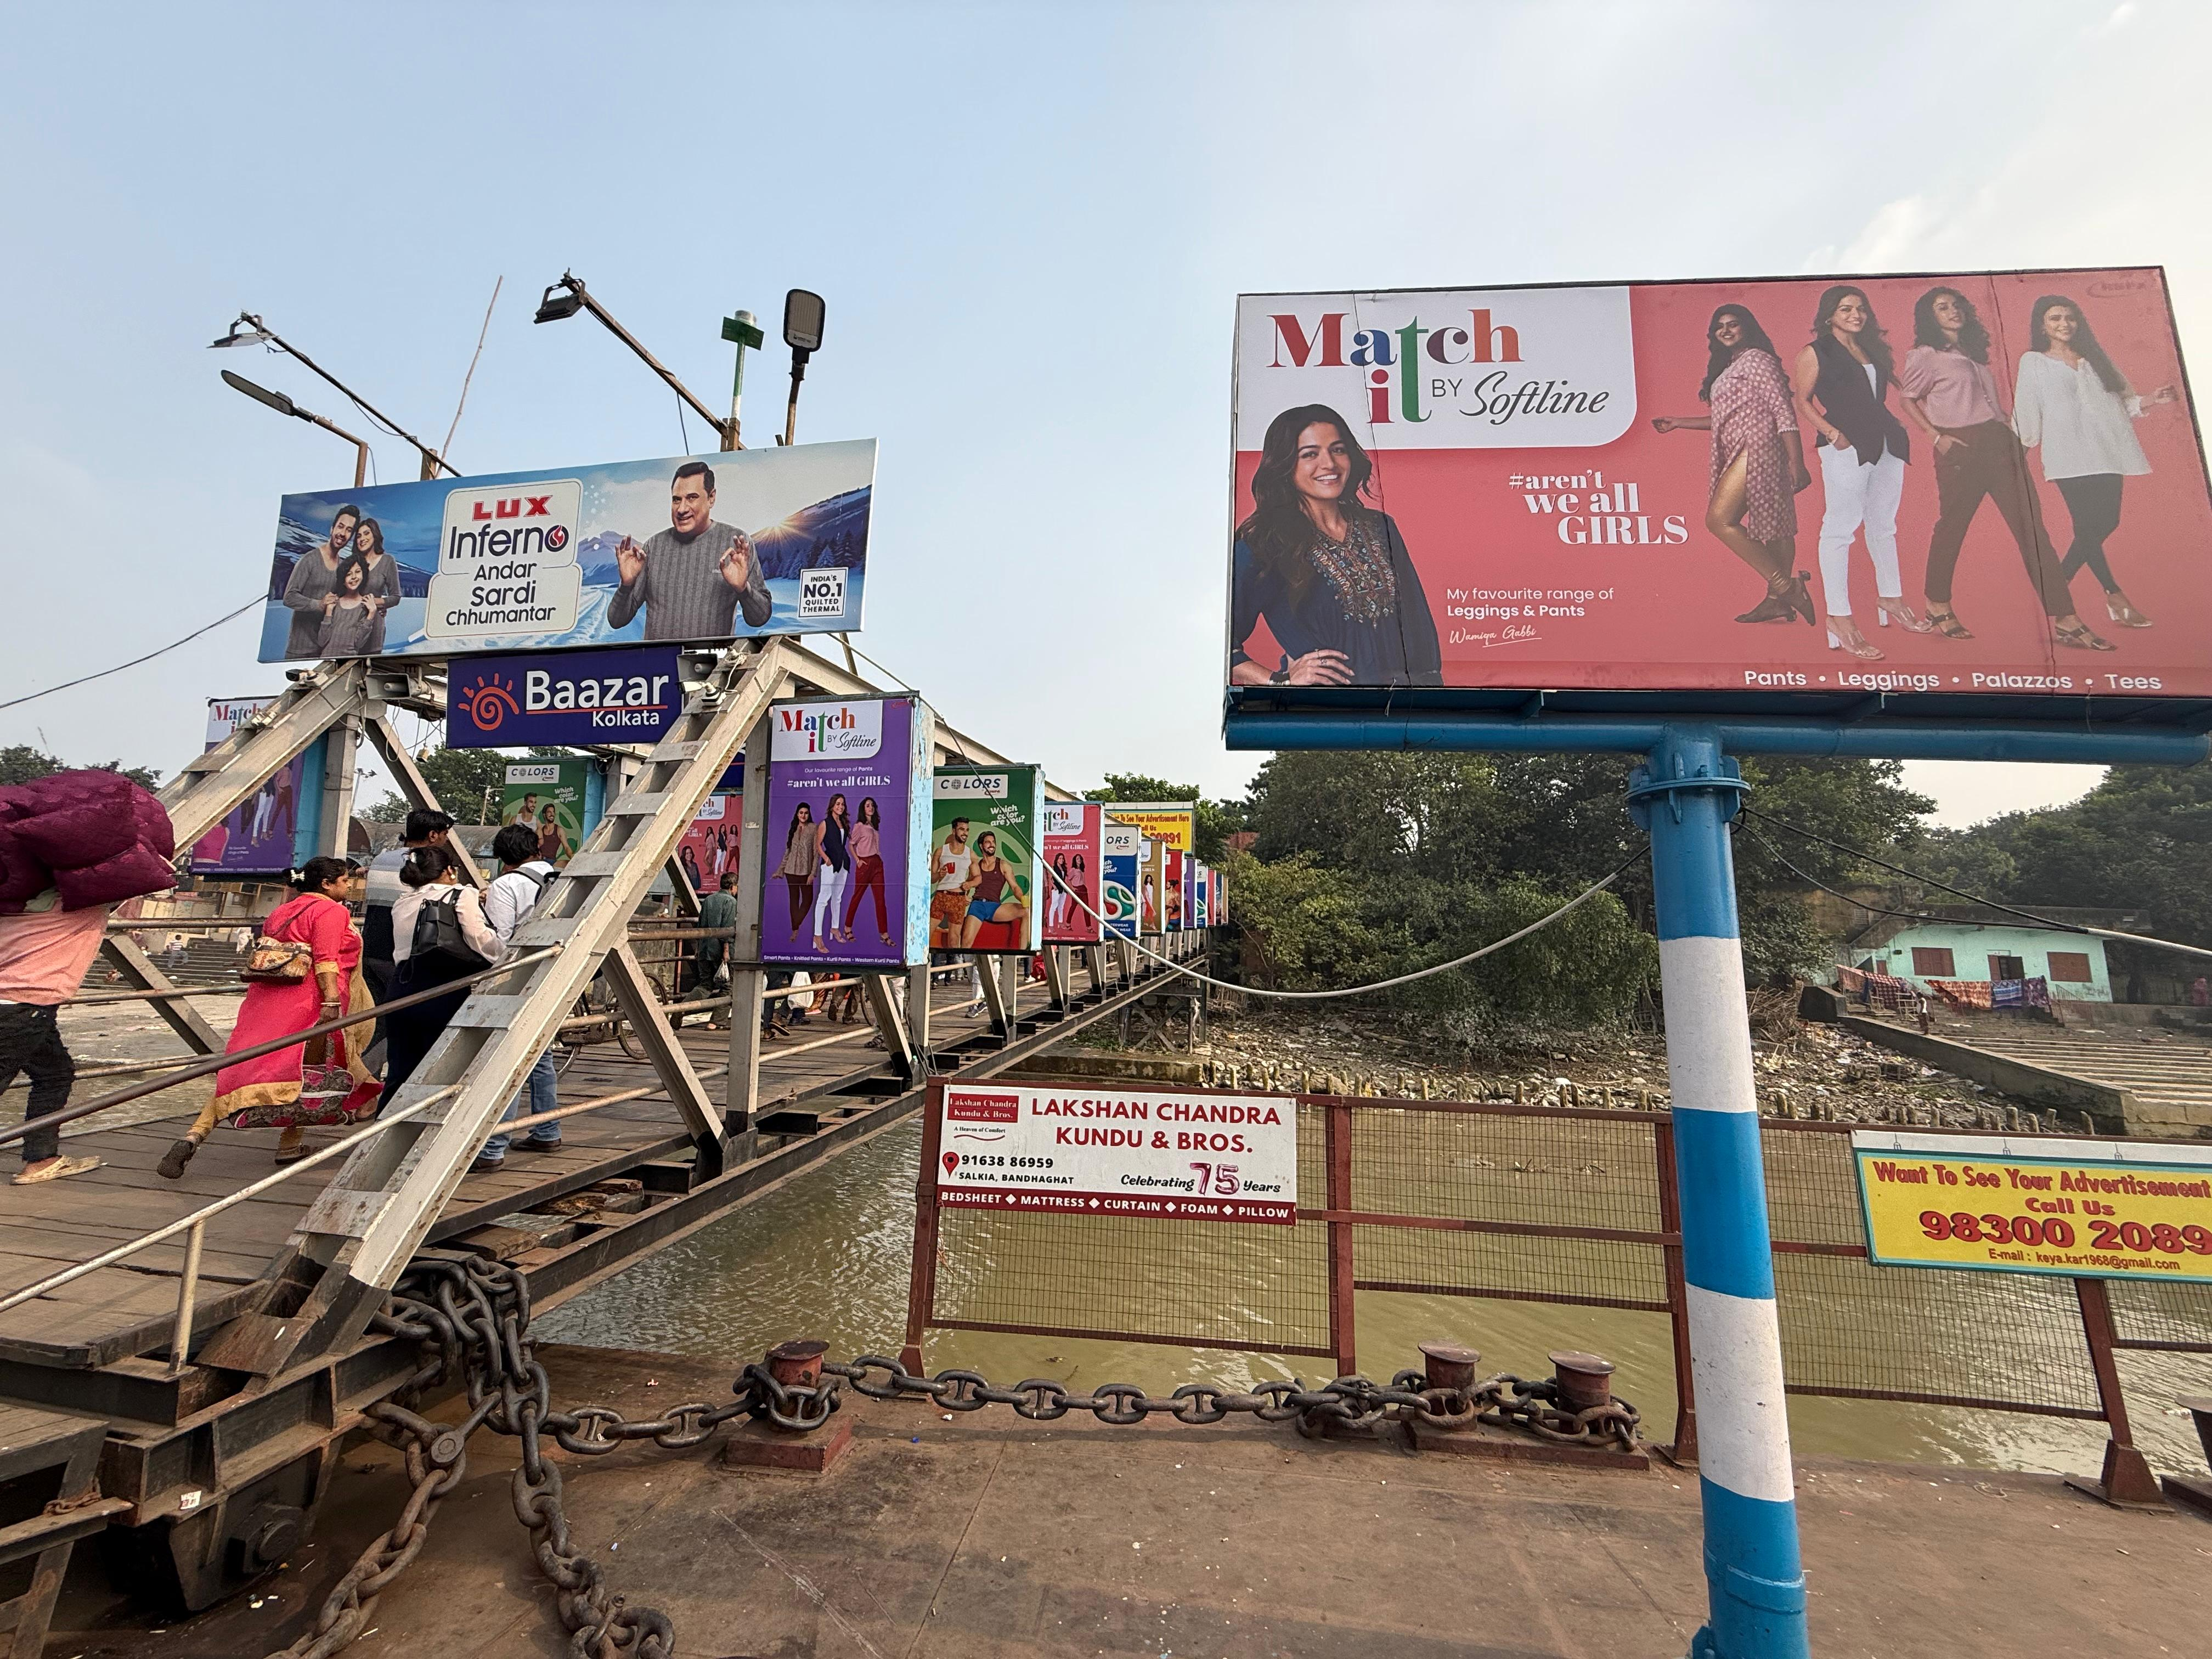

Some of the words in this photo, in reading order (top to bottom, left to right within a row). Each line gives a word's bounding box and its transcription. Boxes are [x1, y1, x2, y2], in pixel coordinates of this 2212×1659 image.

[1266, 309, 1525, 368] Match
[1367, 369, 1432, 424] it
[1432, 379, 1463, 398] BY
[1459, 371, 1610, 425] Softline
[1509, 469, 1606, 490] #aren't
[472, 495, 553, 521] LUX
[1522, 494, 1579, 514] we
[1590, 483, 1641, 513] all
[449, 523, 569, 559] Inferno
[1558, 516, 1689, 545] GIRLS
[473, 561, 537, 581] Andar
[810, 574, 837, 583] INDIA'S
[470, 580, 536, 607] Sardi
[803, 583, 843, 598] NO.1
[1447, 588, 1469, 603] My
[1472, 587, 1543, 600] favourite
[1547, 589, 1594, 603] range
[1599, 588, 1615, 600] of
[445, 606, 557, 626] Chhumantar
[1447, 604, 1519, 620] Leggings
[1523, 605, 1536, 617] &
[1539, 605, 1585, 617] Pants
[526, 670, 669, 710] Baazar
[1745, 670, 1807, 686] Pants
[1838, 670, 1940, 692] Leggings
[1972, 672, 2073, 689] Palazzos
[2104, 673, 2162, 691] Tees
[592, 709, 659, 727] Kolkata
[779, 707, 856, 732] Match
[808, 731, 828, 753] it
[827, 735, 837, 743] BY
[835, 731, 877, 751] Softline
[554, 786, 574, 794] Which
[826, 779, 840, 787] we
[842, 776, 855, 787] all
[857, 775, 891, 787] GIRLS
[990, 804, 1018, 815] Which
[1106, 836, 1130, 844] ORS
[950, 1098, 981, 1107] Lakshan
[984, 1099, 1017, 1108] Chandra
[954, 1109, 981, 1118] Kundu
[1032, 1098, 1148, 1120] LAKSHAN
[1156, 1103, 1282, 1125] CHANDRA
[1056, 1127, 1143, 1148] KUNDU
[1151, 1129, 1170, 1149] &
[1177, 1131, 1254, 1153] BROS.
[961, 1154, 1005, 1166] 91638
[1009, 1156, 1053, 1169] 86959
[958, 1172, 998, 1182] SALKIA,
[1002, 1174, 1074, 1184] BANDHAGHAT
[1120, 1174, 1195, 1192] Celebrating
[1189, 1163, 1240, 1196] 75
[1872, 1161, 1928, 1184] Want
[1932, 1164, 1958, 1186] To
[1965, 1166, 2001, 1188] See
[2004, 1168, 2053, 1191] Your
[2061, 1171, 2212, 1198] Advertisement
[941, 1192, 1002, 1204] BEDSHEET
[1020, 1195, 1085, 1207] MATTRESS
[1104, 1199, 1161, 1212] CURTAIN
[1181, 1203, 1218, 1215] FOAM
[1238, 1206, 1289, 1218] PILLOW
[2025, 1197, 2075, 1215] Call
[2083, 1200, 2115, 1216] Us
[1920, 1211, 2075, 1248] 98300
